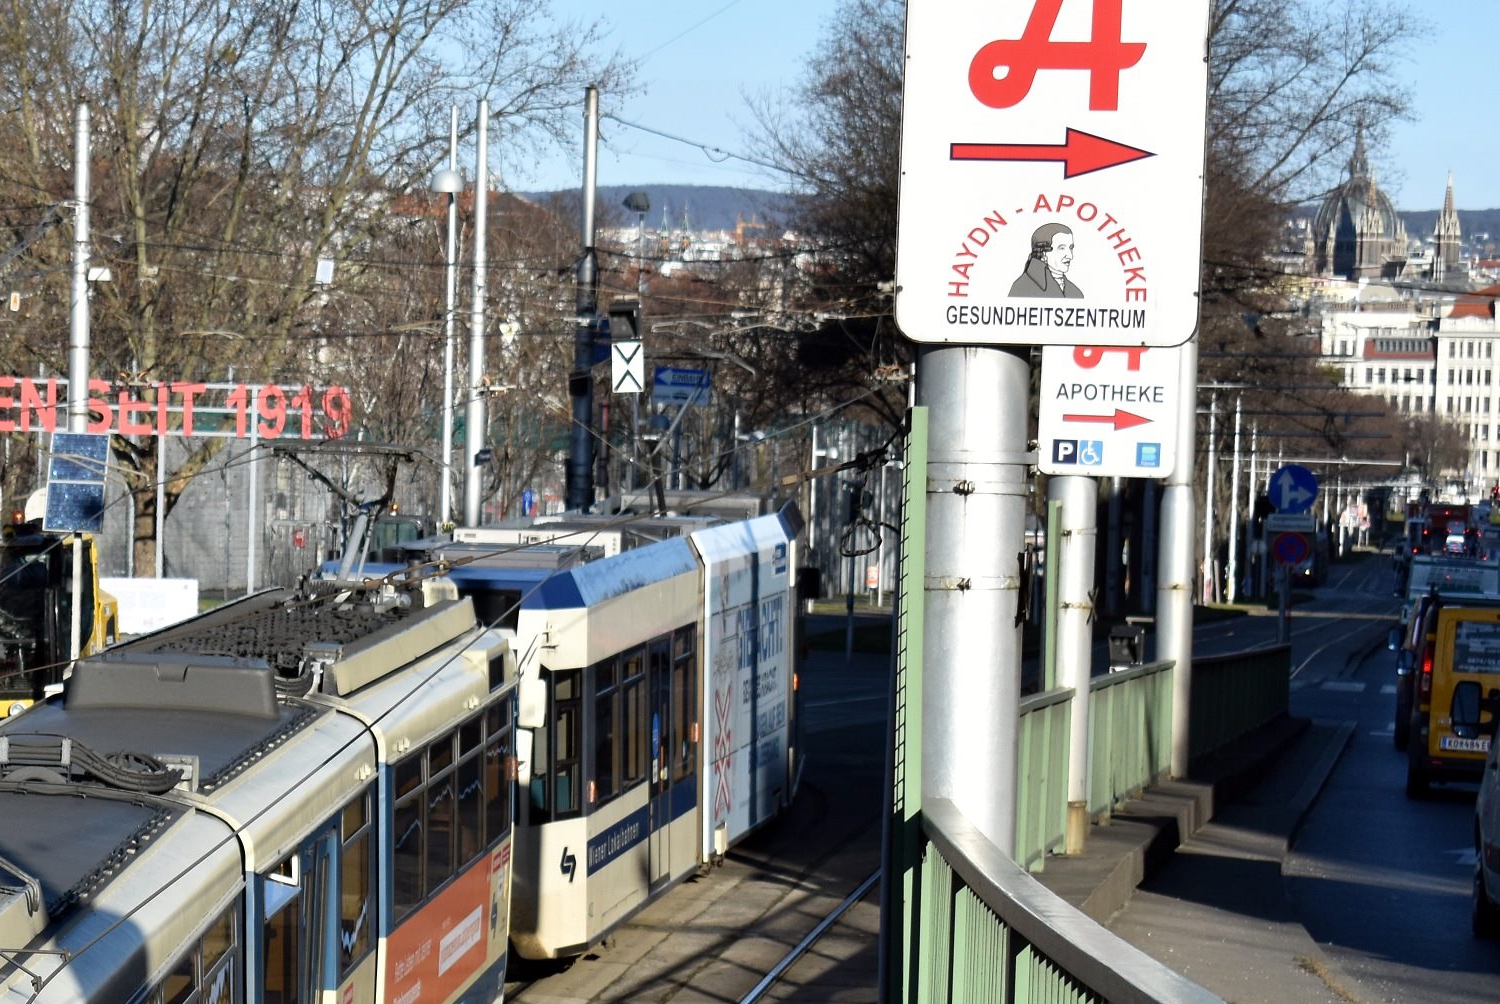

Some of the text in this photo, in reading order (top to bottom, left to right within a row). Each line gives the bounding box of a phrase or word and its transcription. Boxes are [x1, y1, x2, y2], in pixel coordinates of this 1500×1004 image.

[947, 209, 1008, 297] HAYDN
[1032, 193, 1148, 303] APOTHEKE
[946, 304, 1146, 329] GESUNDHEITSZENTRUM
[87, 378, 206, 437] SEIT
[226, 382, 352, 440] 1919
[1056, 382, 1165, 404] APOTHEKE
